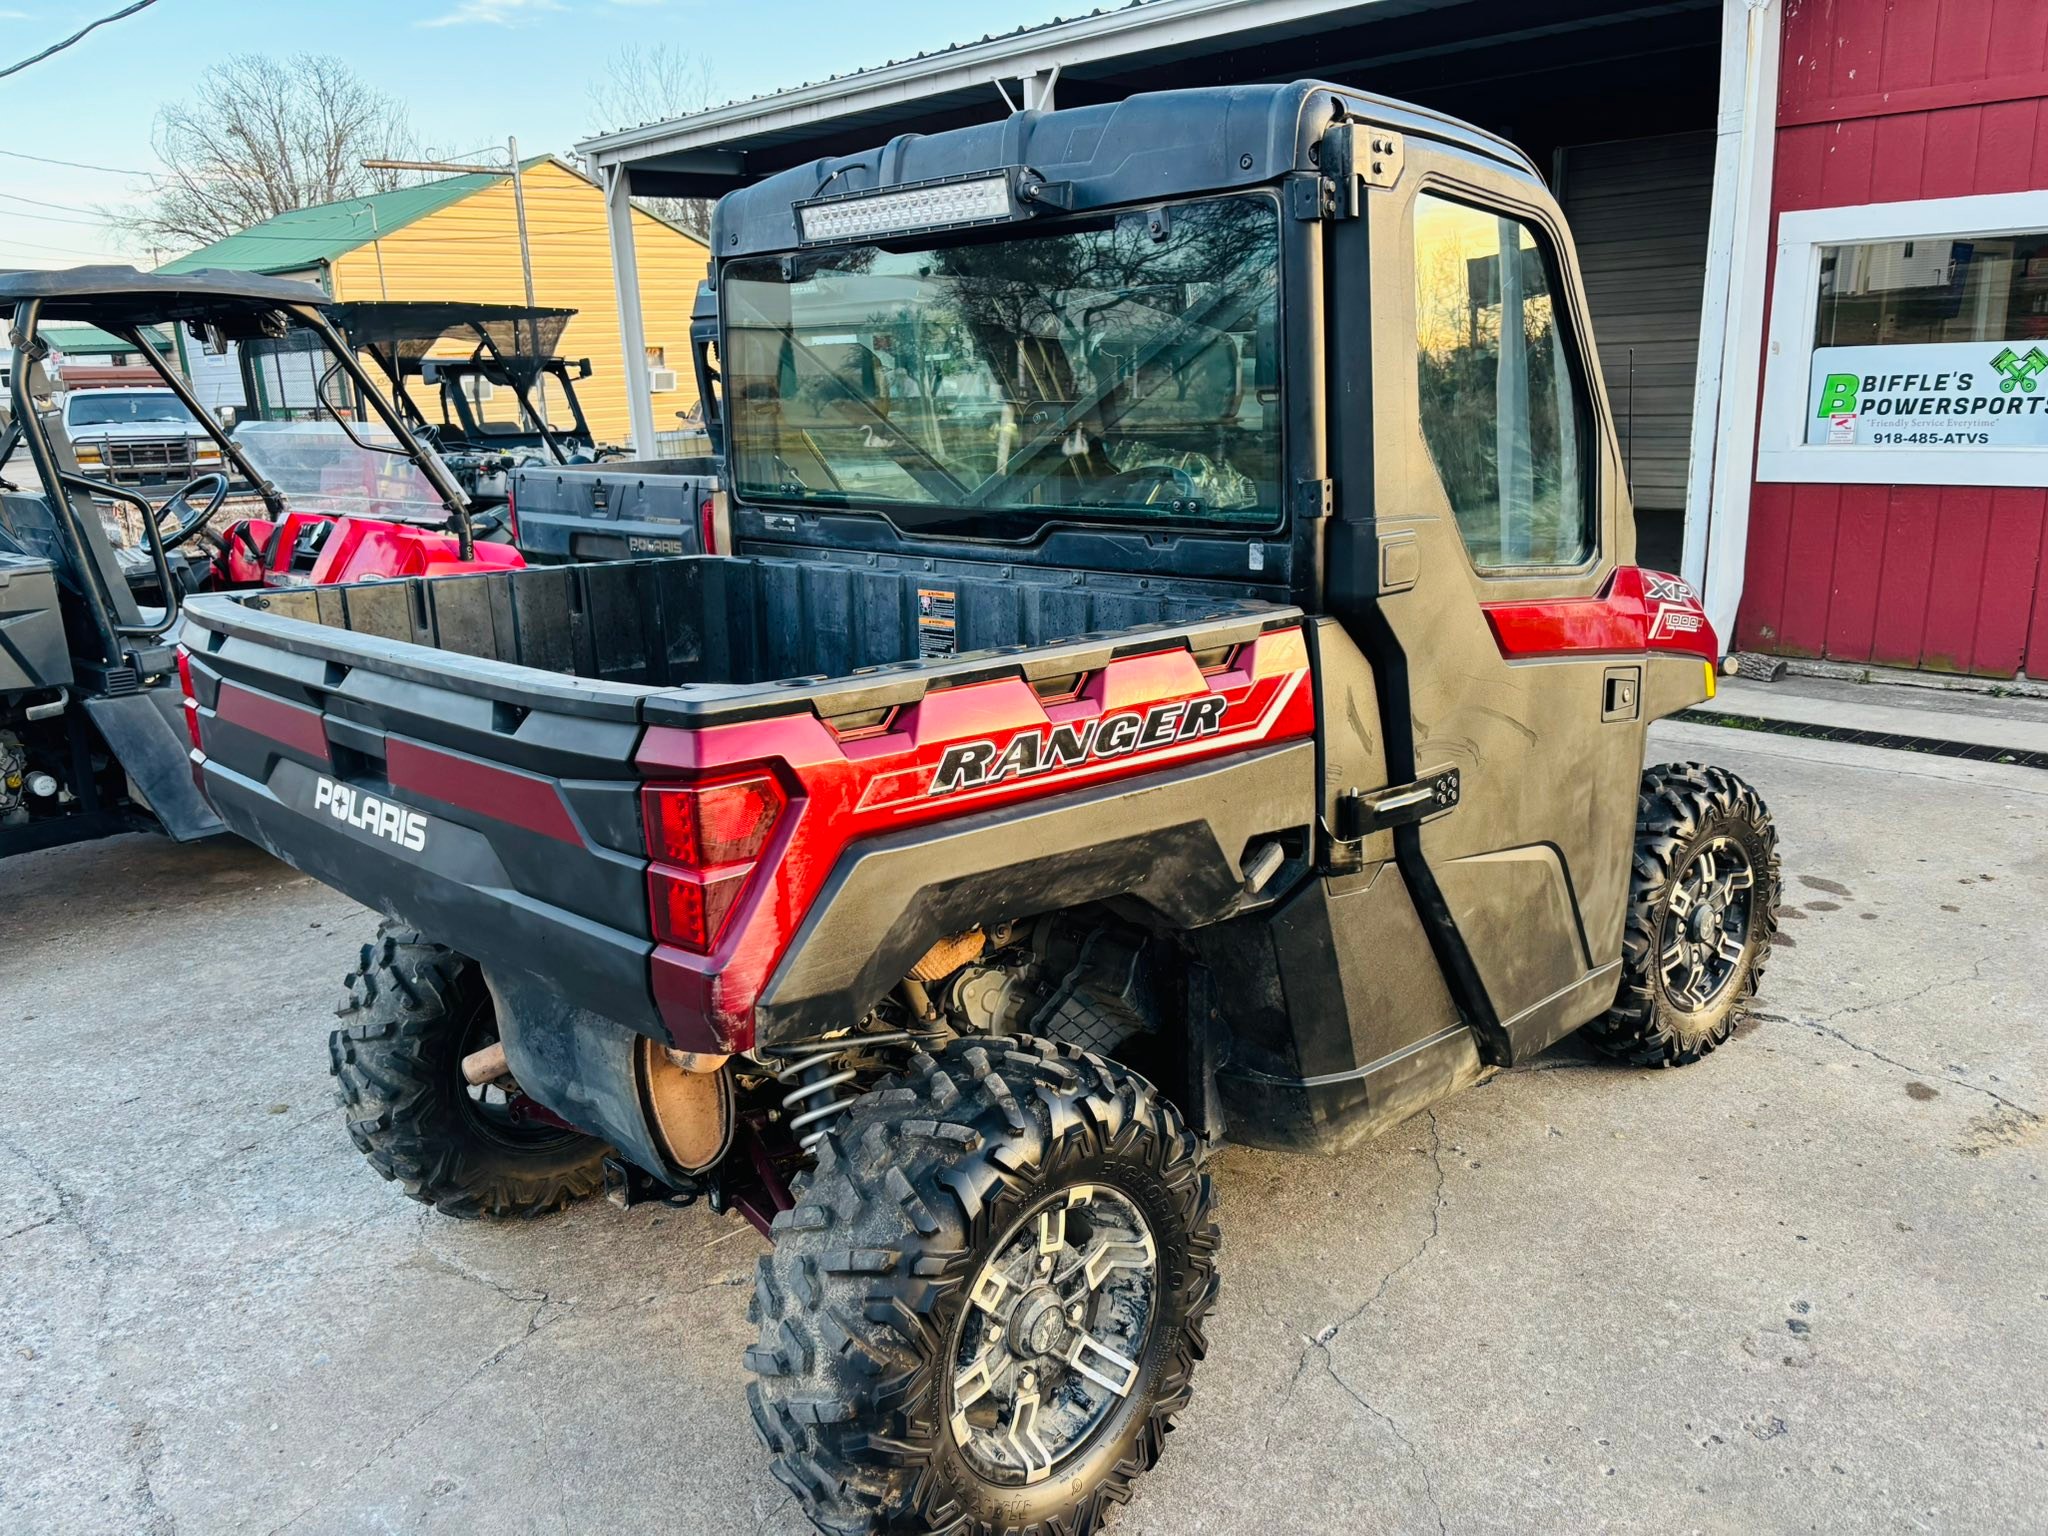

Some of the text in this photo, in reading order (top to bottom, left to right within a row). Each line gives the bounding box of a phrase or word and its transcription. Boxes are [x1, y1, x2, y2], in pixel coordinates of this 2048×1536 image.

[1861, 371, 1973, 392] BIFFLE'S
[1817, 373, 1860, 418] B
[1911, 419, 1944, 428] Service
[1873, 432, 1989, 444] 918-485-ATVS
[628, 536, 683, 555] POLARIS
[1644, 575, 1693, 602] XP
[1665, 612, 1698, 628] 1000
[927, 694, 1228, 797] RANGER
[314, 776, 427, 852] POLARIS
